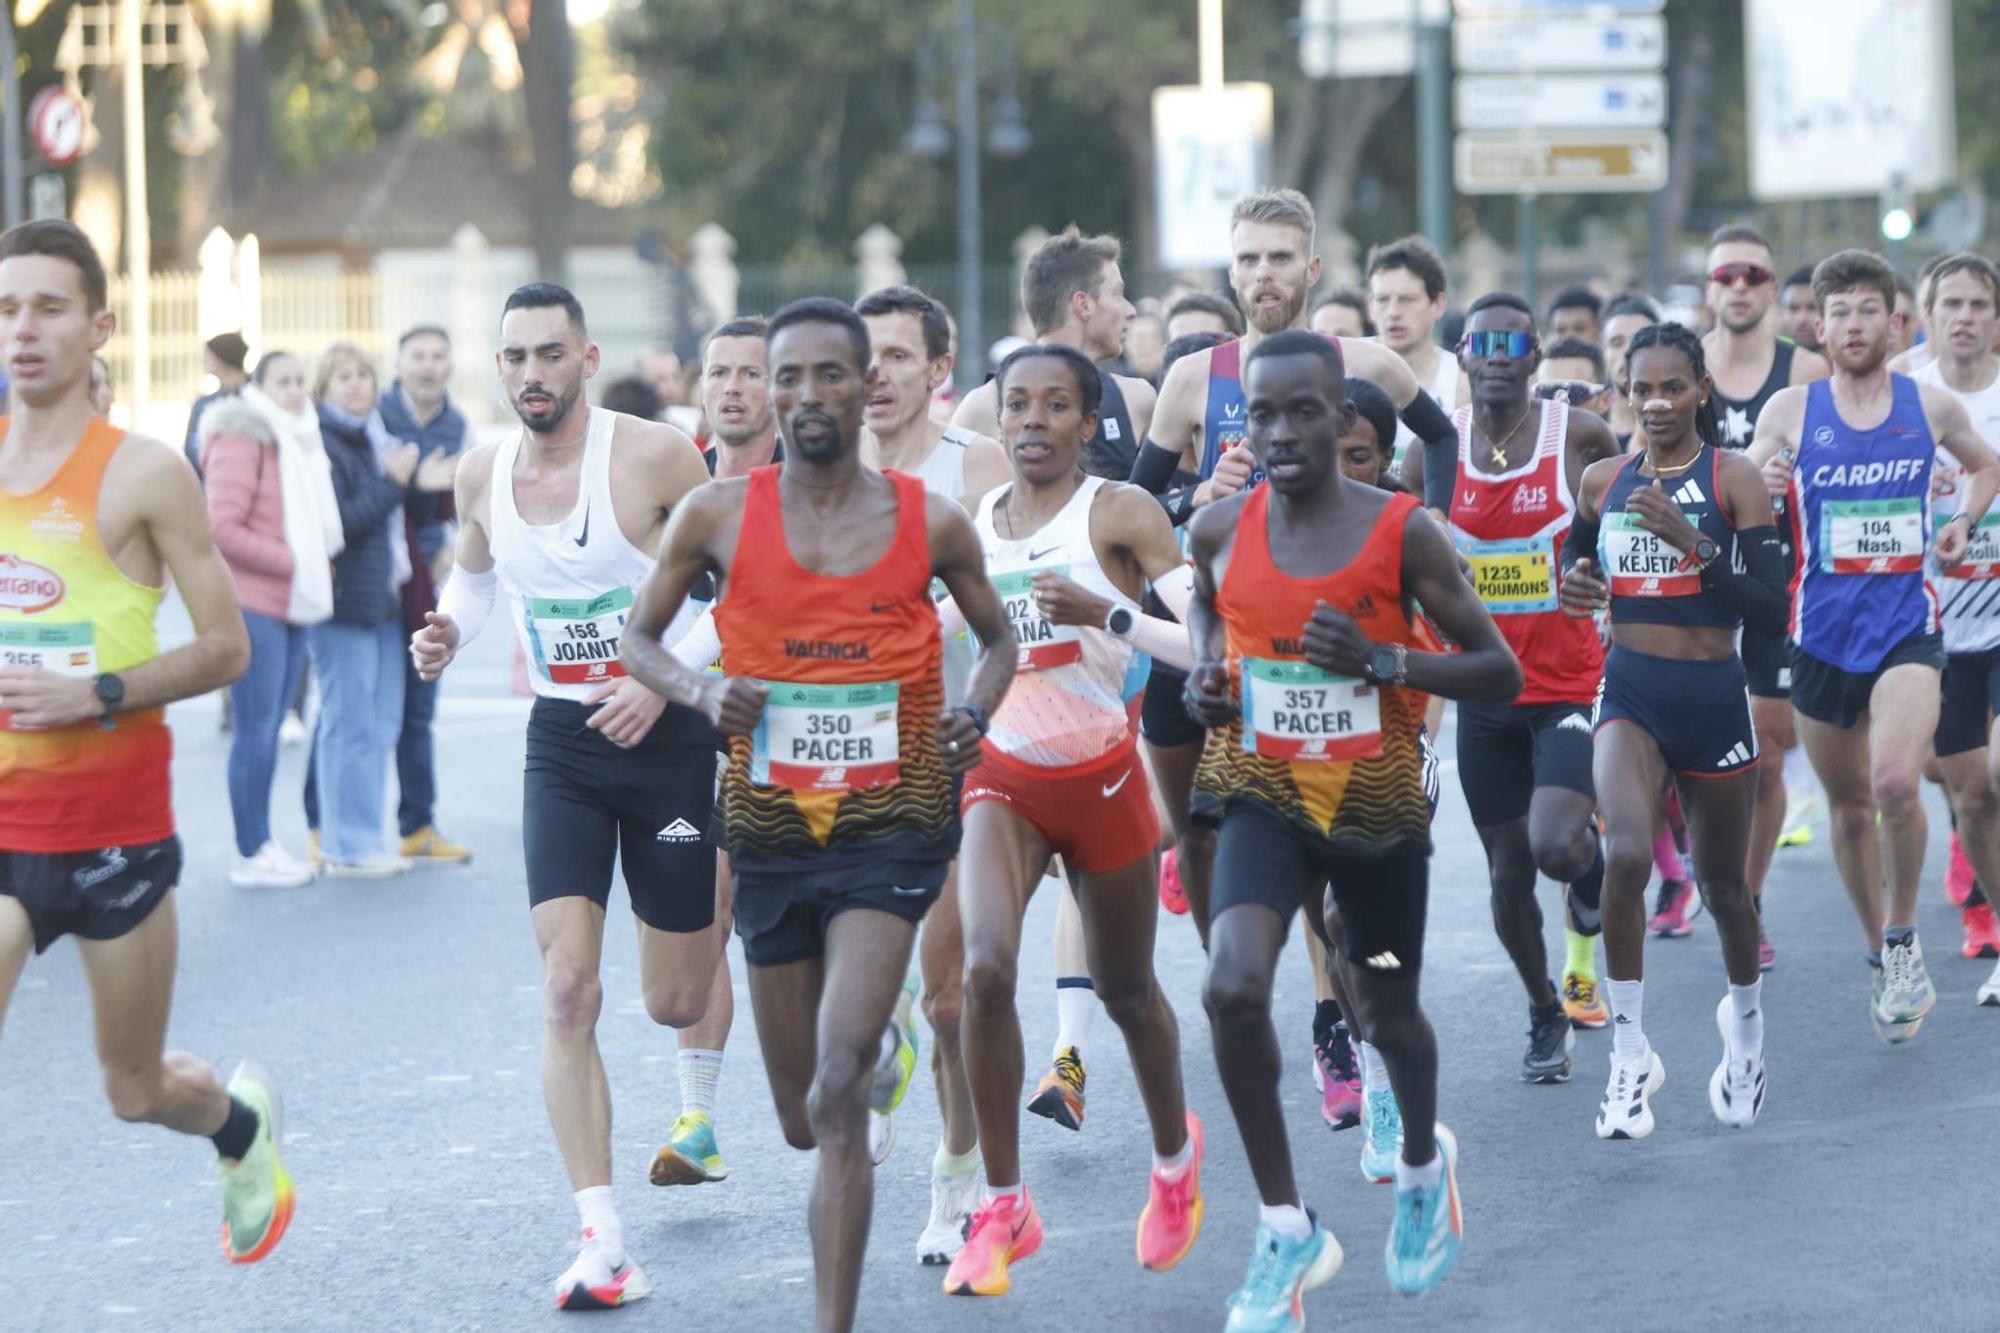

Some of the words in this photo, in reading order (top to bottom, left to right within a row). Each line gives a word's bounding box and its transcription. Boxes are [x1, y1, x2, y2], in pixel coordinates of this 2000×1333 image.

[1812, 458, 1925, 488] CARDIFF
[1861, 521, 1891, 536] 104
[1630, 535, 1660, 553] 215
[1857, 537, 1902, 554] Nash
[1479, 565, 1522, 581] 1235
[1618, 554, 1679, 574] KEJETA
[564, 622, 600, 640] 158
[552, 636, 619, 662] JOANIT
[784, 637, 870, 662] VALENCIA
[1284, 689, 1328, 710] 357
[806, 713, 852, 735] 350
[1273, 709, 1353, 734] PACER
[792, 736, 874, 761] PACER
[656, 835, 677, 843] NIKE
